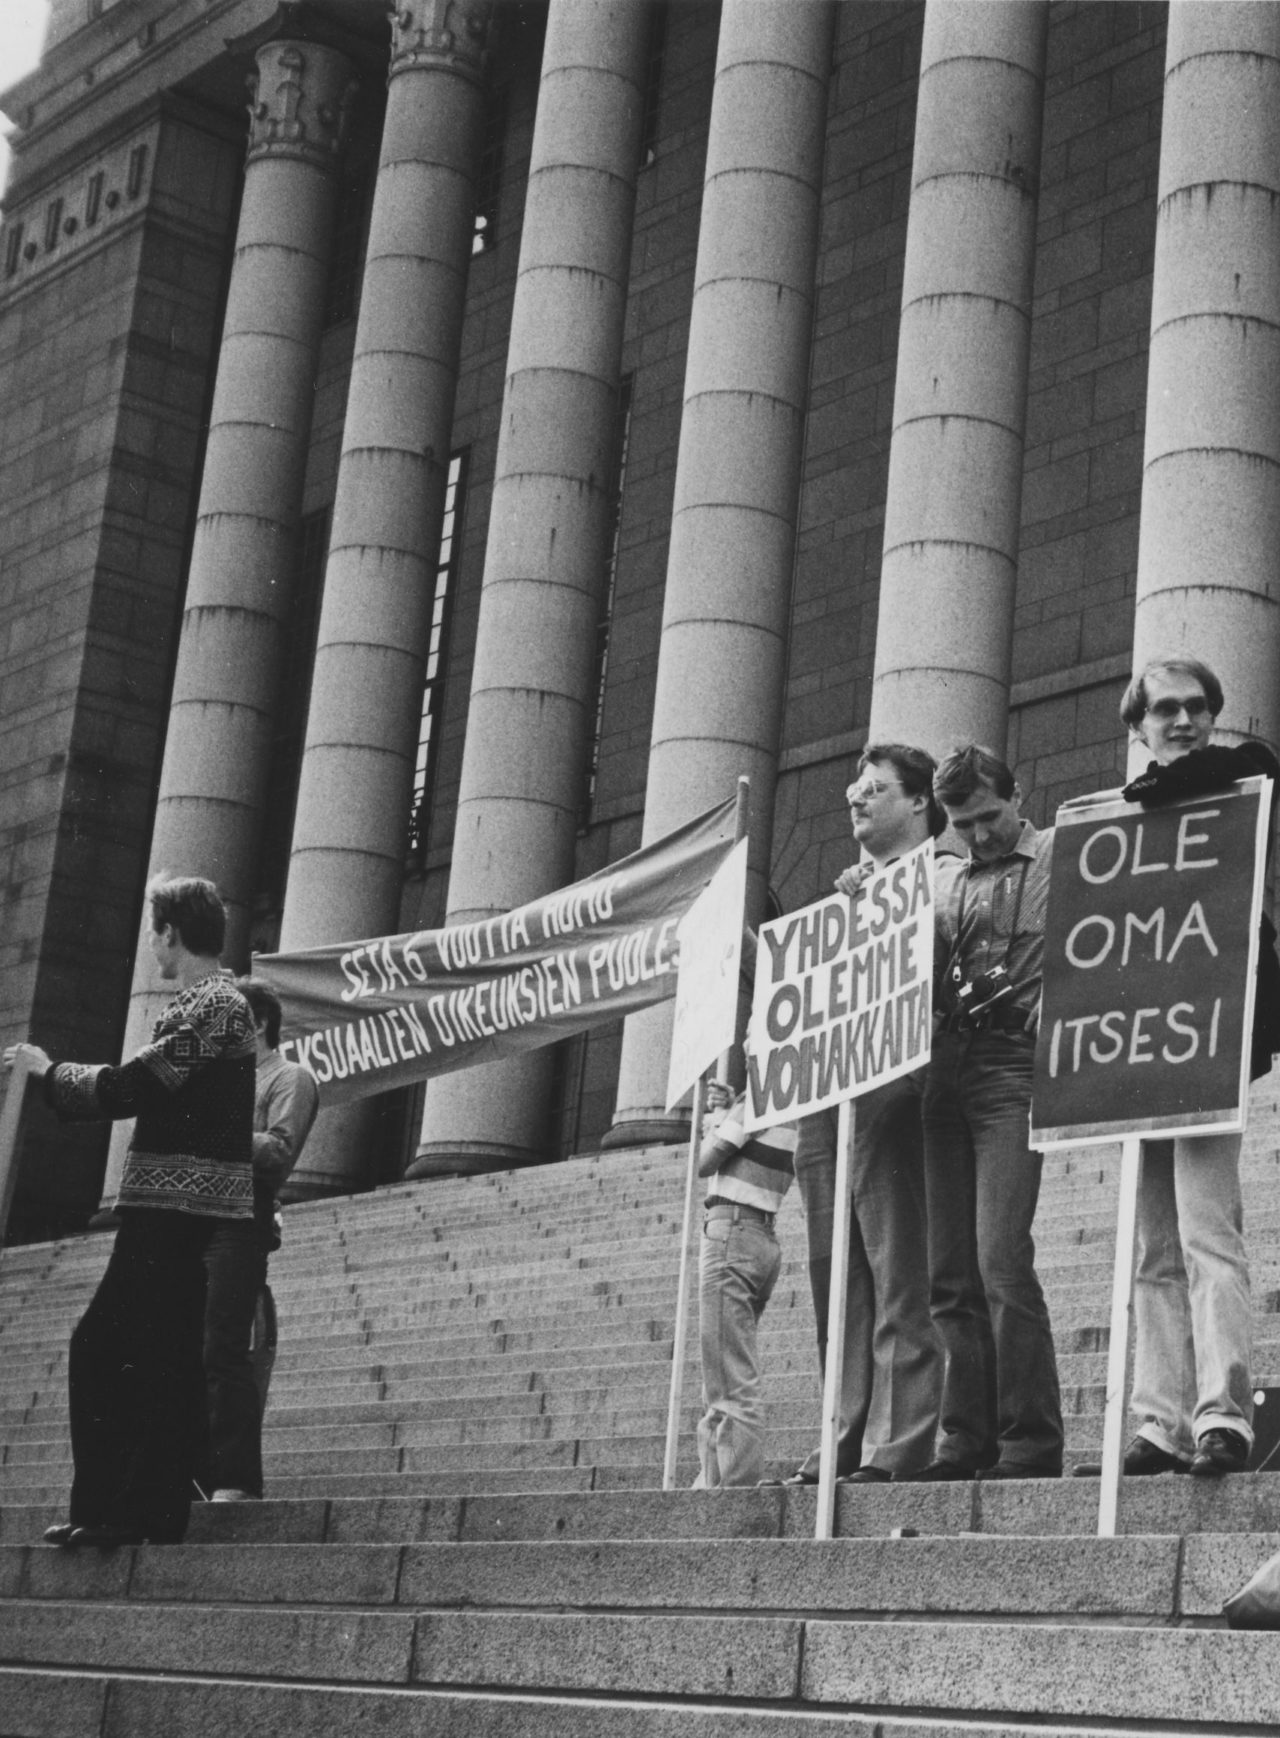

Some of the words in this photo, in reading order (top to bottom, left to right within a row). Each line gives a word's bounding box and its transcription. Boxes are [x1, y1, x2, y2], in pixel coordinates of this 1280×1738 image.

[1079, 808, 1221, 885] OLE
[340, 940, 408, 1002] SETA
[403, 934, 428, 981] 6
[436, 909, 531, 970] VUOTTA
[762, 849, 932, 984] YHDESSÄ
[1065, 900, 1219, 969] OMA
[428, 951, 581, 1046] OIKEUKSIEN
[766, 923, 919, 1042] OLEMME
[747, 979, 931, 1119] VOIMAKKAITA
[1049, 998, 1222, 1078] ITSESI
